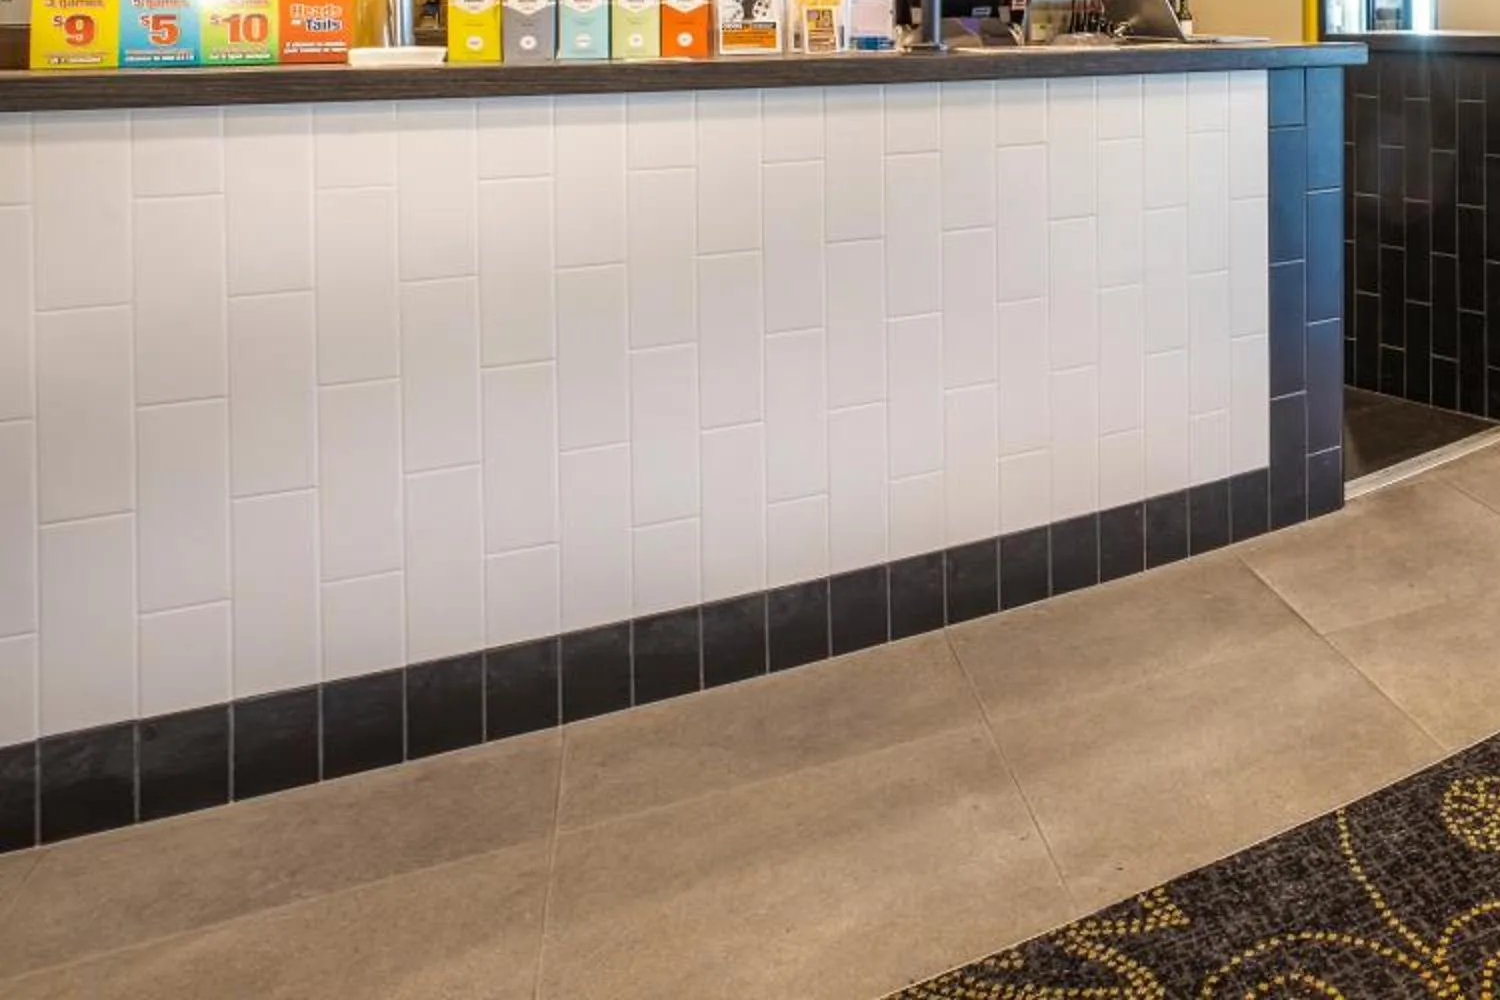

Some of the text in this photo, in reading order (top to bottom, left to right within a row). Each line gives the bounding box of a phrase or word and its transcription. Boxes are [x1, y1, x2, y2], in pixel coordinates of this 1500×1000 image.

[53, 13, 96, 47] $9
[140, 13, 181, 46] $5
[210, 13, 269, 44] $10
[305, 18, 343, 32] Tails
